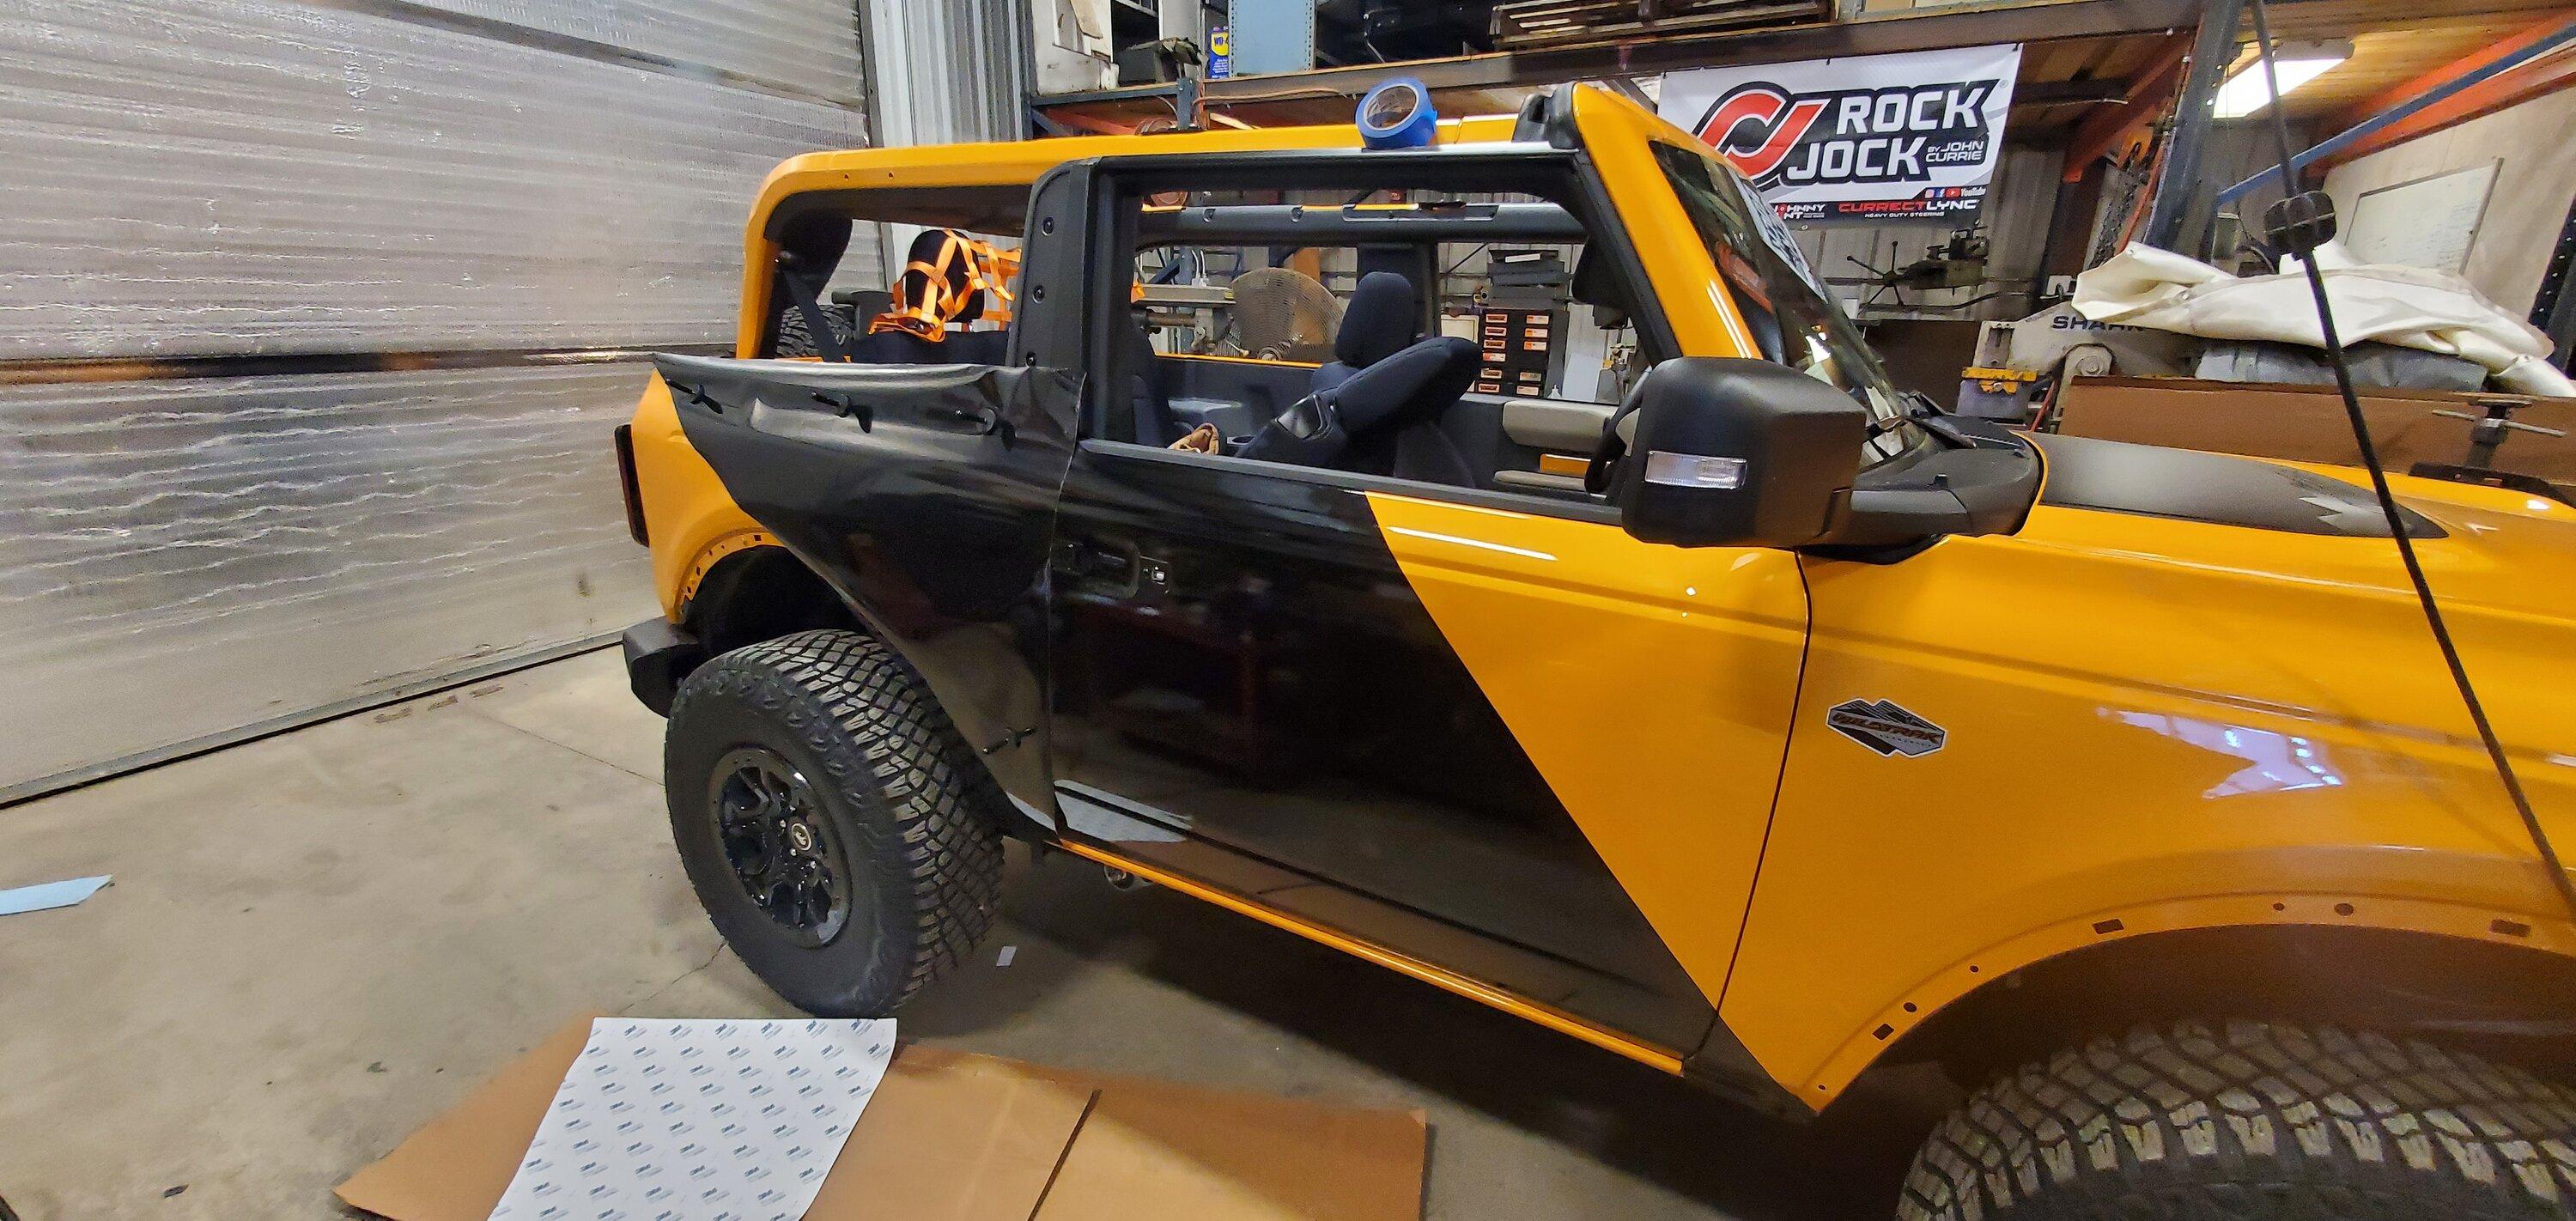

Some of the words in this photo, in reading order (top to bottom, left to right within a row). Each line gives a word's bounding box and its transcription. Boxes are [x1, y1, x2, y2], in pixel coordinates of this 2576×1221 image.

[1836, 88, 1986, 135] ROCK
[1787, 137, 1928, 180] JOCK
[1925, 150, 1983, 162] CURRIE
[1941, 140, 1984, 152] JOHN
